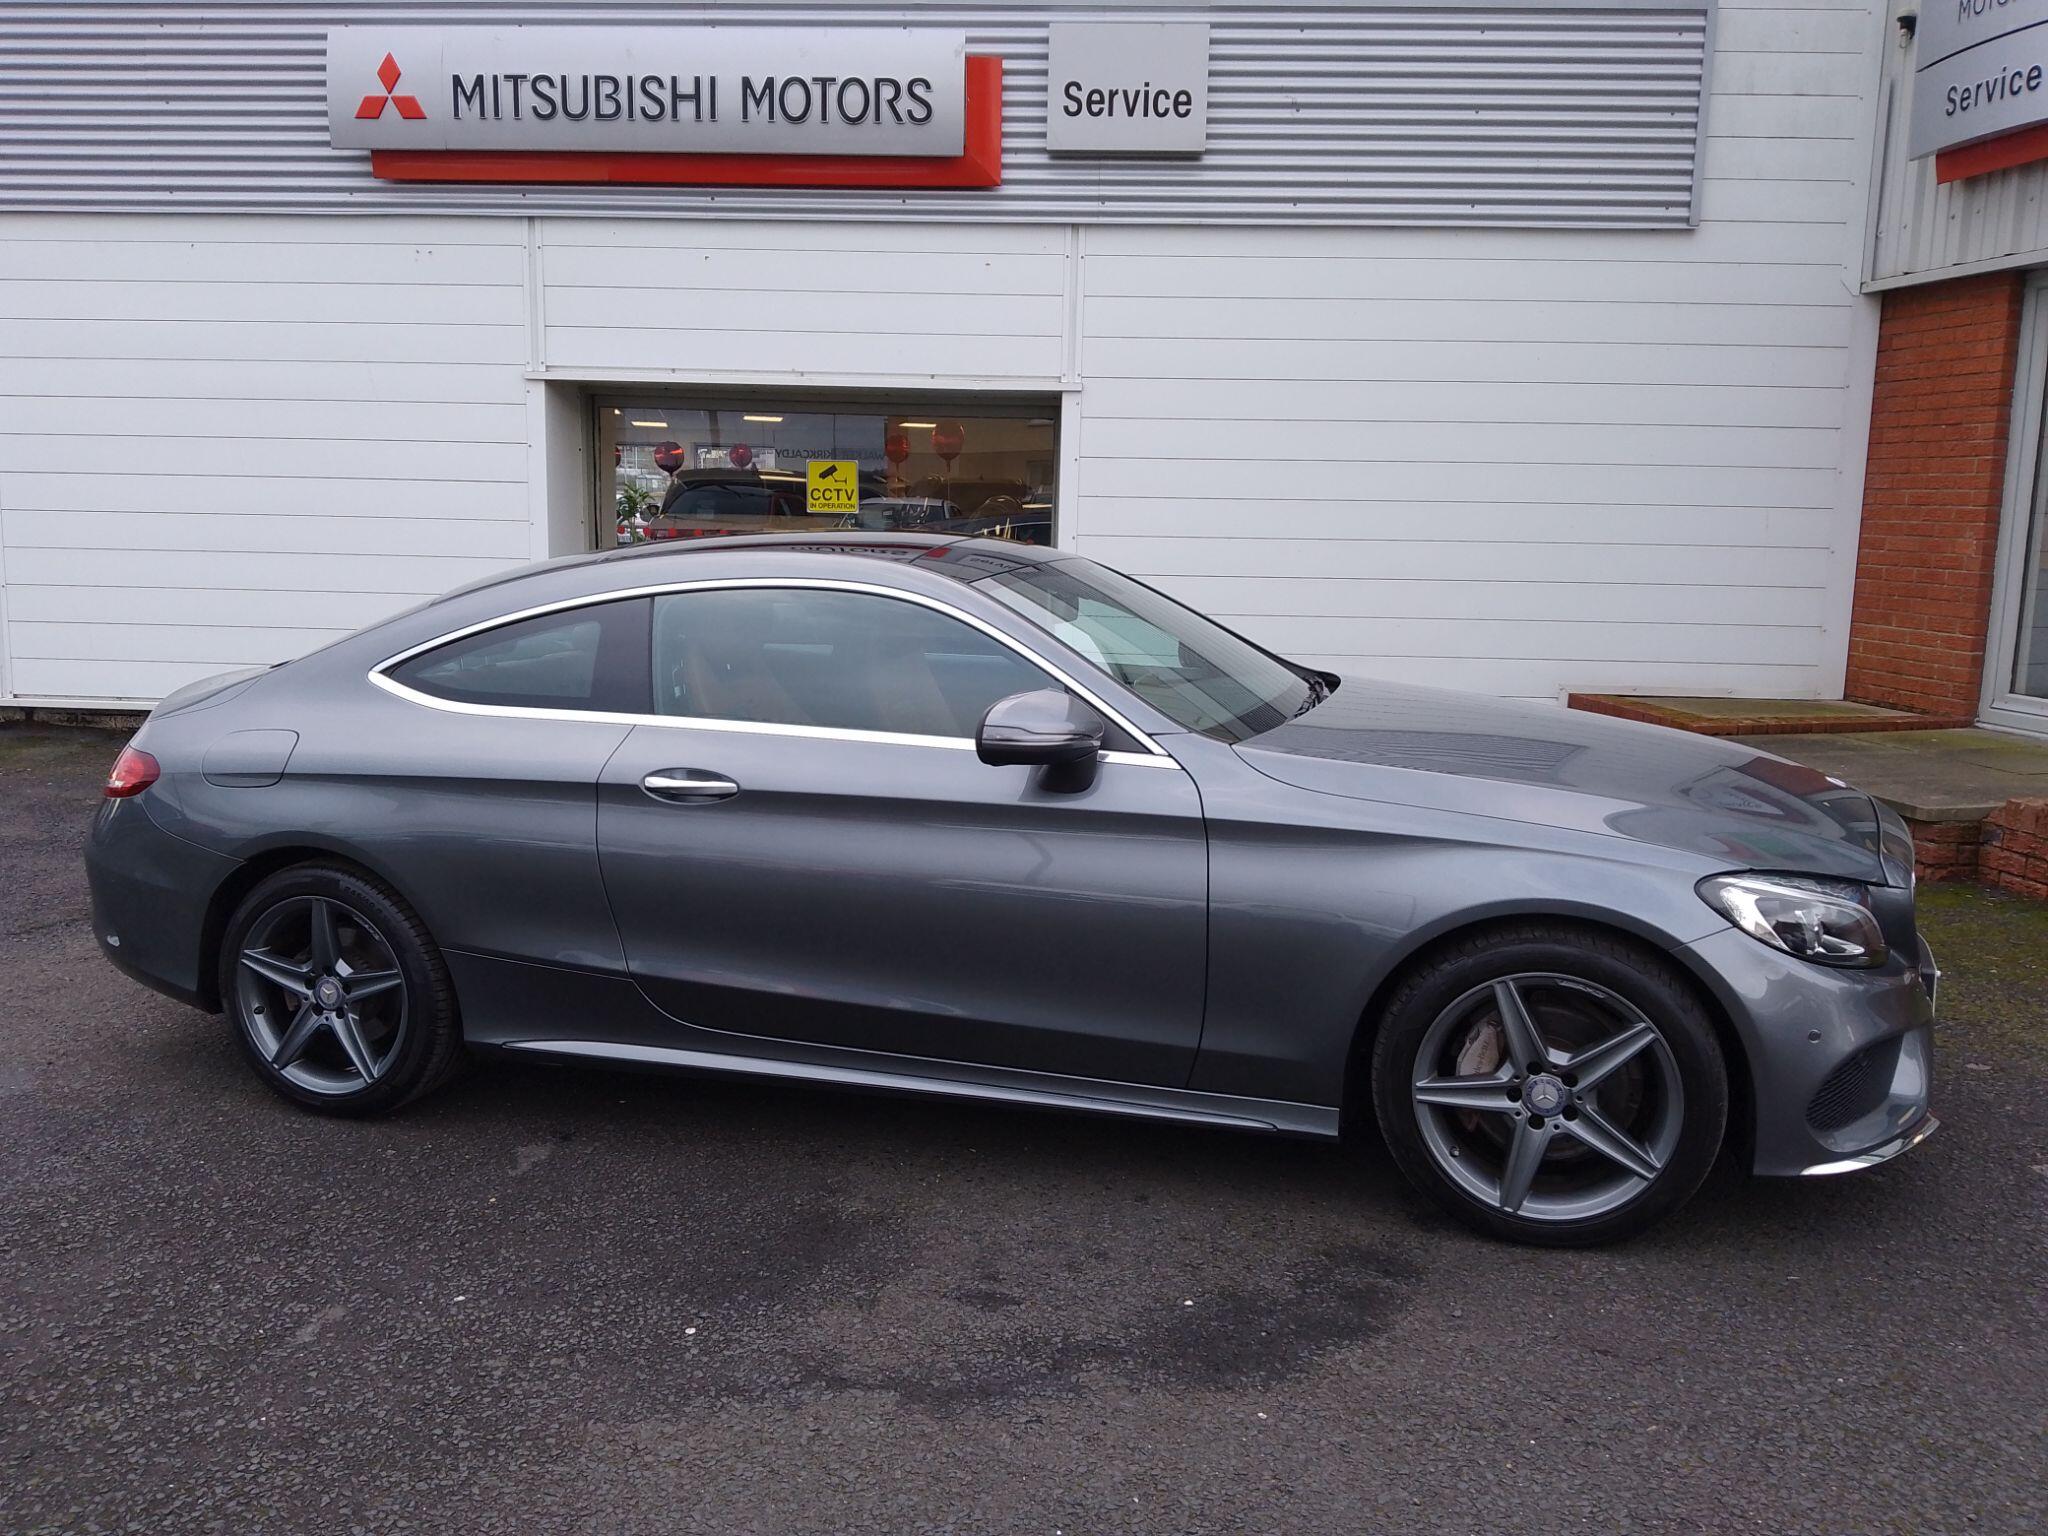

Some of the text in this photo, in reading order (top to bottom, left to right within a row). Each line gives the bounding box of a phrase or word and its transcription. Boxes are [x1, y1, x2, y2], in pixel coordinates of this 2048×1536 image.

[452, 74, 933, 124] MITSUBISHI MOTORS
[1063, 81, 1192, 118] Service
[1946, 64, 2042, 116] Service
[811, 488, 855, 501] CCTV
